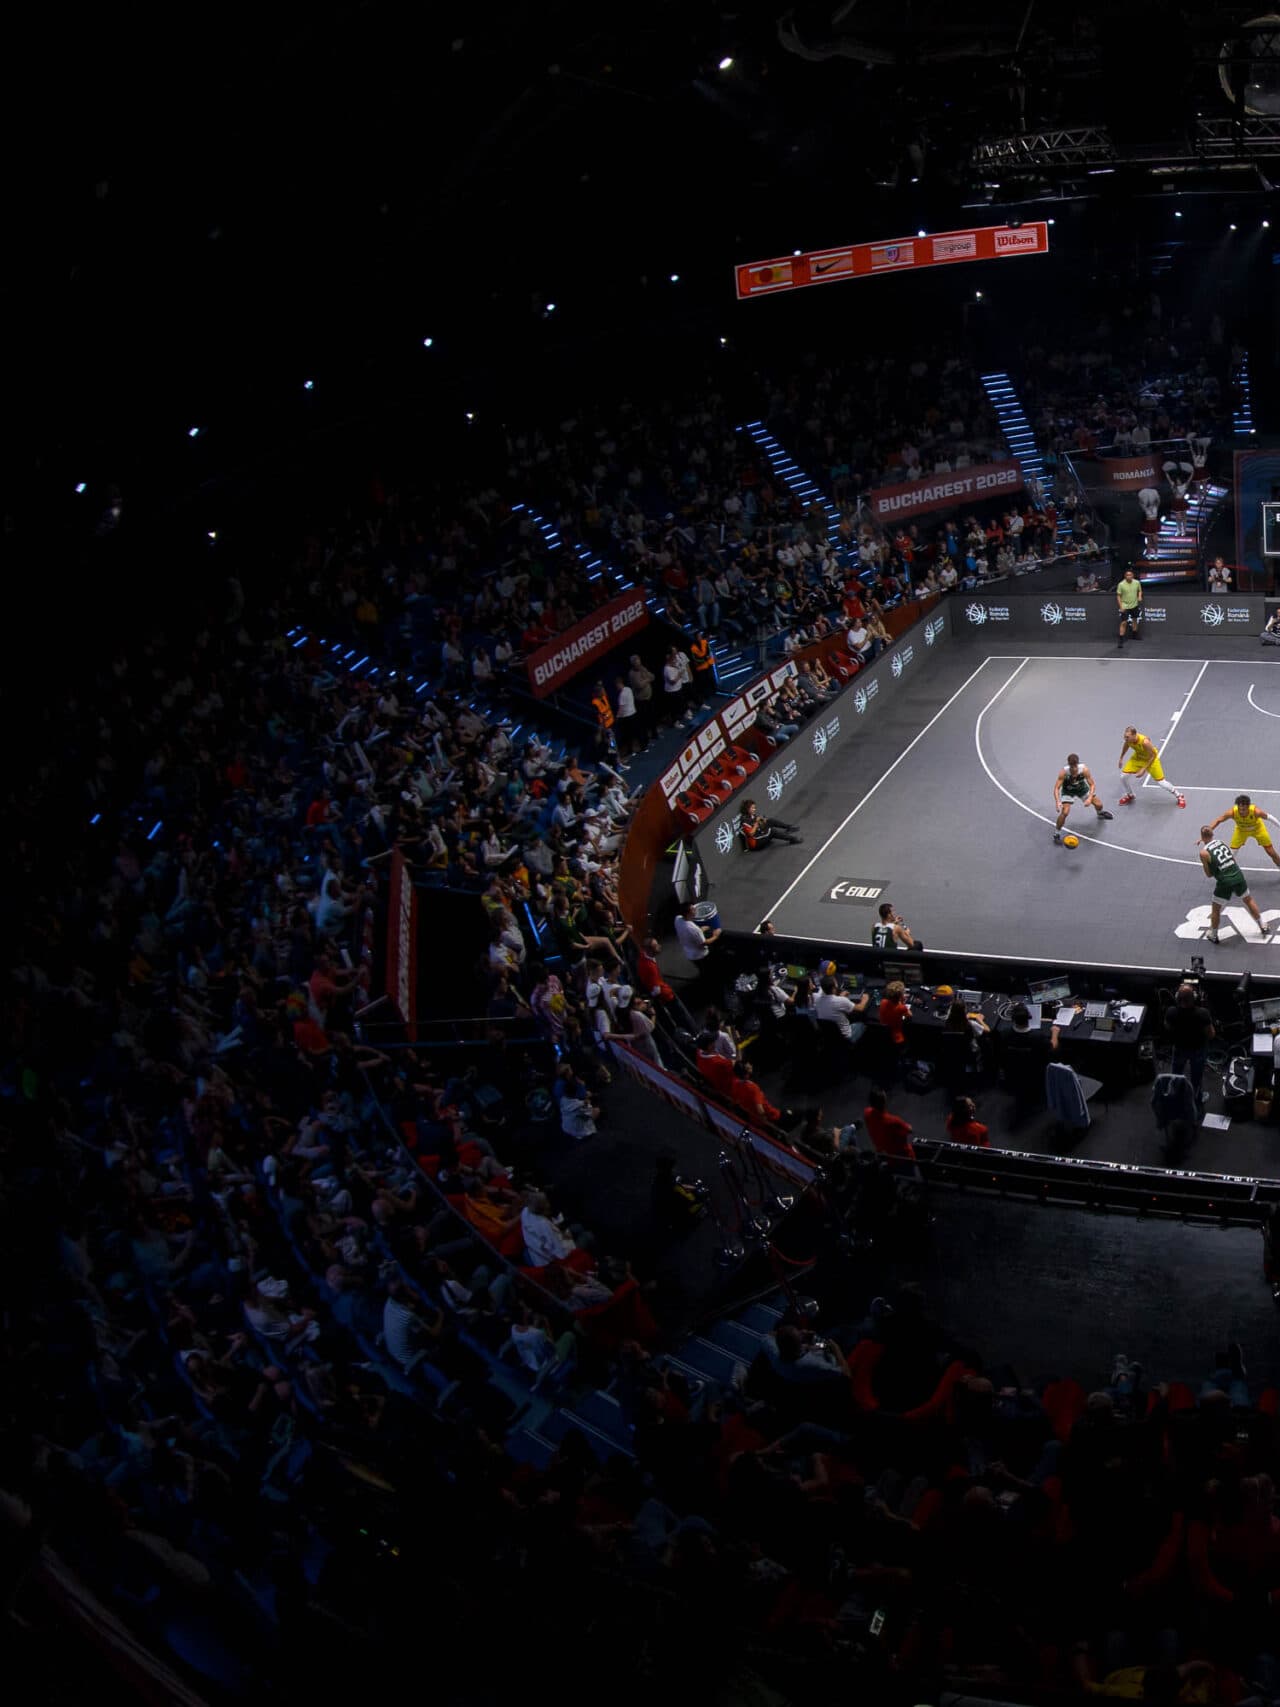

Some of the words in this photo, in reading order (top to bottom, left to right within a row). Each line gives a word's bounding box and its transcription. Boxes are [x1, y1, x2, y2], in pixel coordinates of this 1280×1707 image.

[996, 234, 1034, 247] Wilson
[878, 478, 973, 513] BUCHAREST
[975, 469, 1017, 490] 2022
[534, 620, 610, 686] BUCHAREST
[611, 600, 644, 633] 2022
[1213, 845, 1233, 864] 22
